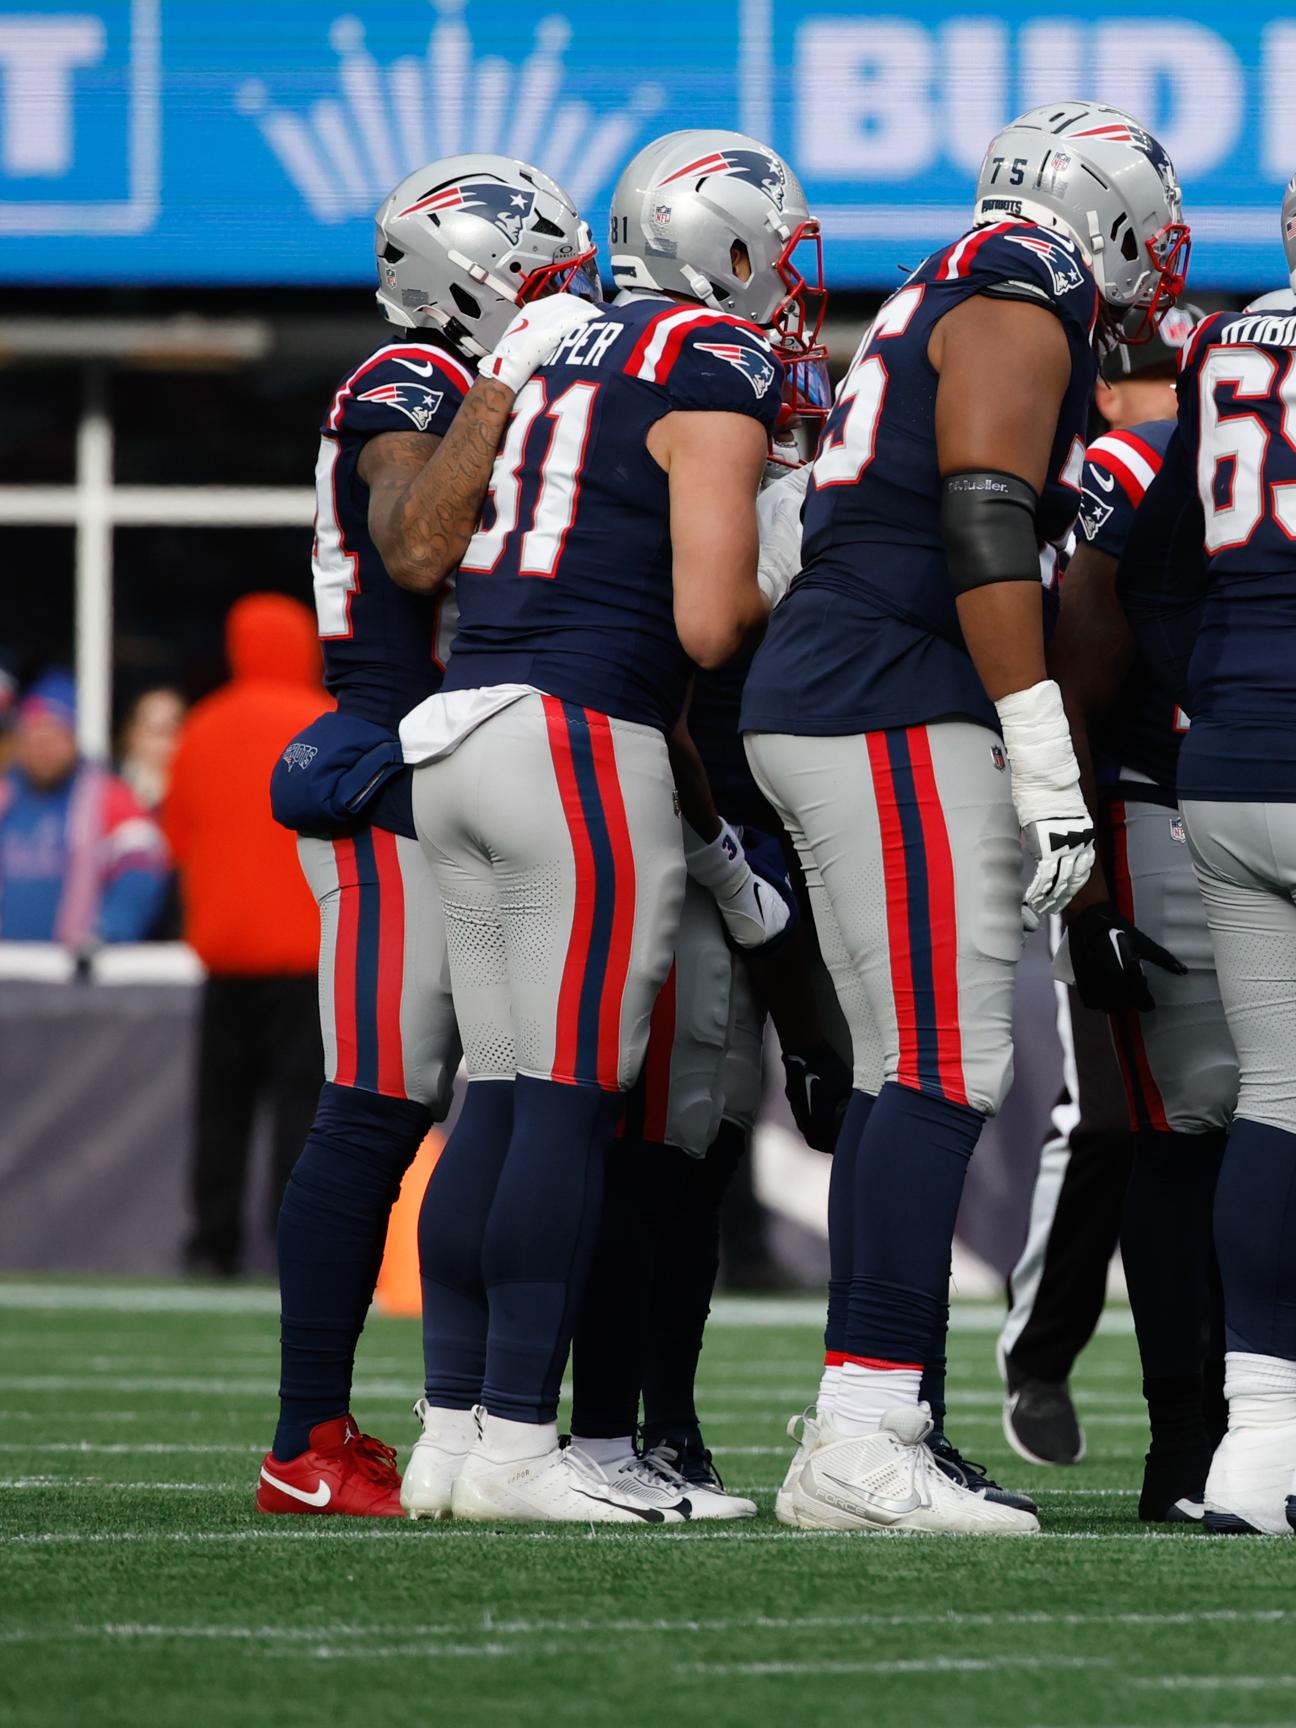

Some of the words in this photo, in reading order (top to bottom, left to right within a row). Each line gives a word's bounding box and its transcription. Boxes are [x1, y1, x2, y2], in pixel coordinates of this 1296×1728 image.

[795, 16, 1242, 180] BUD
[990, 157, 1028, 185] 75
[611, 216, 628, 244] 81
[542, 321, 624, 366] PER
[815, 1489, 867, 1518] FORCE
